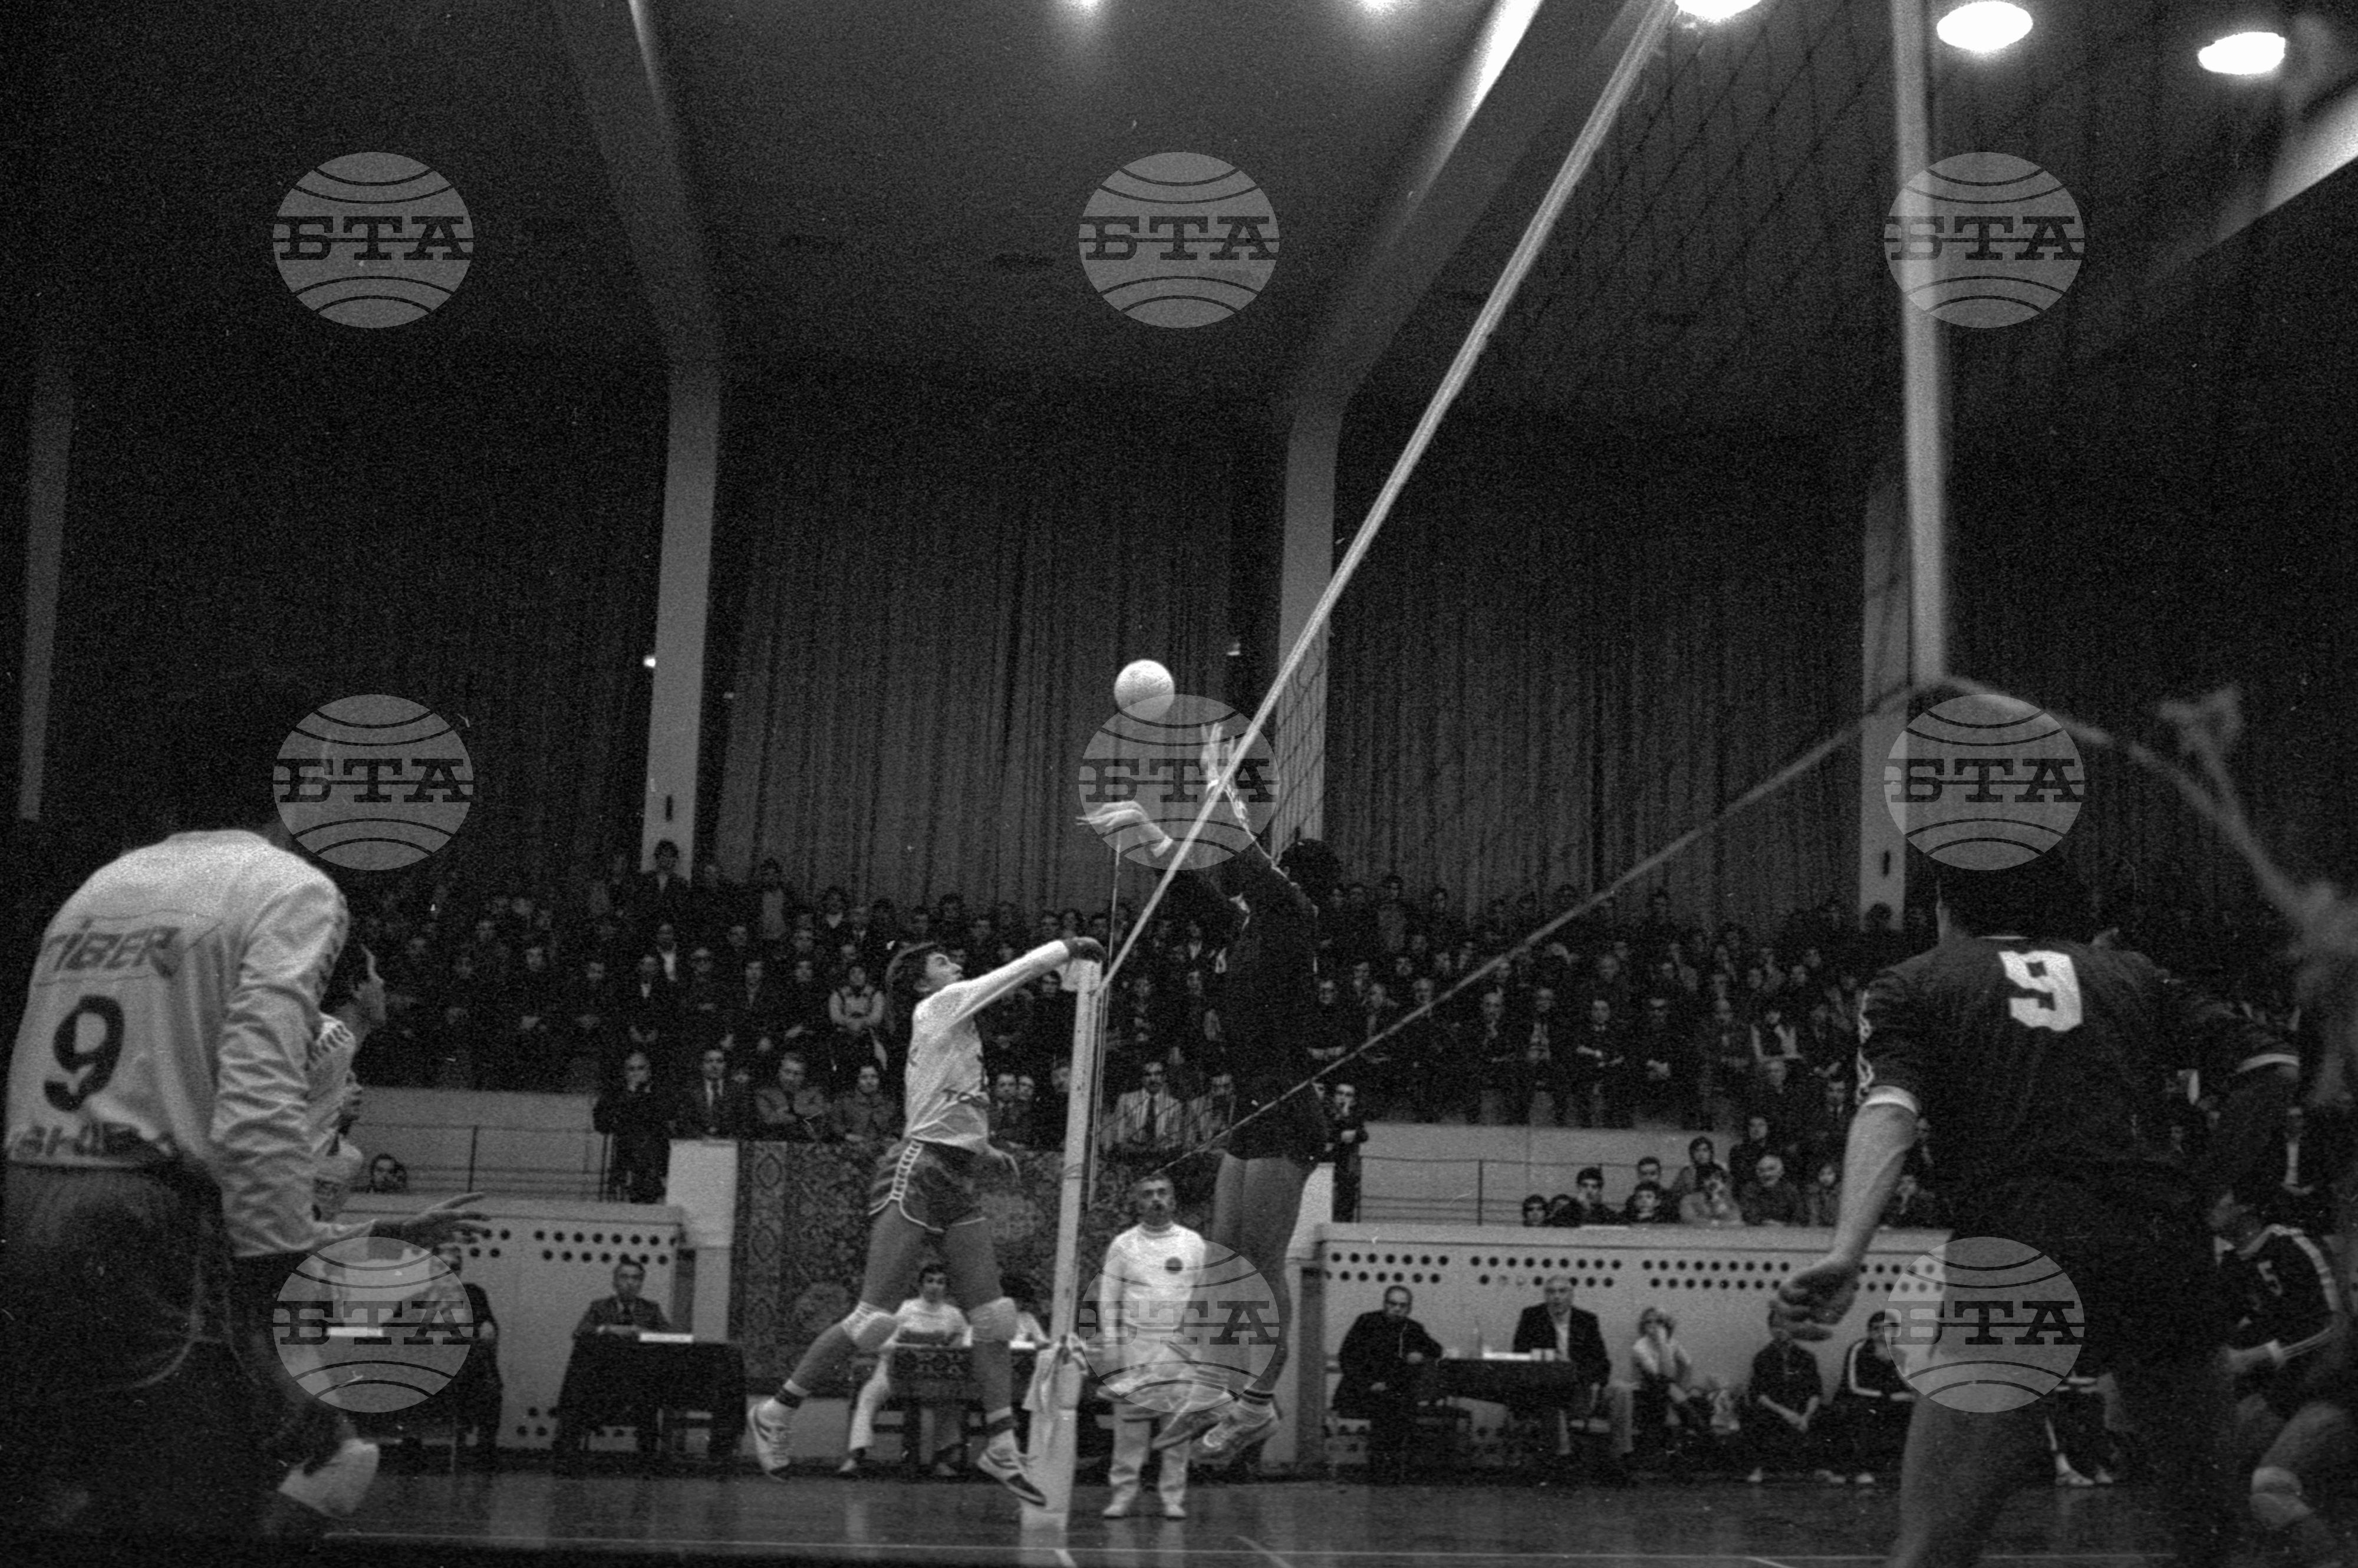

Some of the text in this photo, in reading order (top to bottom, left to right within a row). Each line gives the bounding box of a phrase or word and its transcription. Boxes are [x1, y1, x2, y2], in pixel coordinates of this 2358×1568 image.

[1998, 950, 2082, 1032] 9
[44, 994, 125, 1114] 9
[2256, 1259, 2284, 1297] 5
